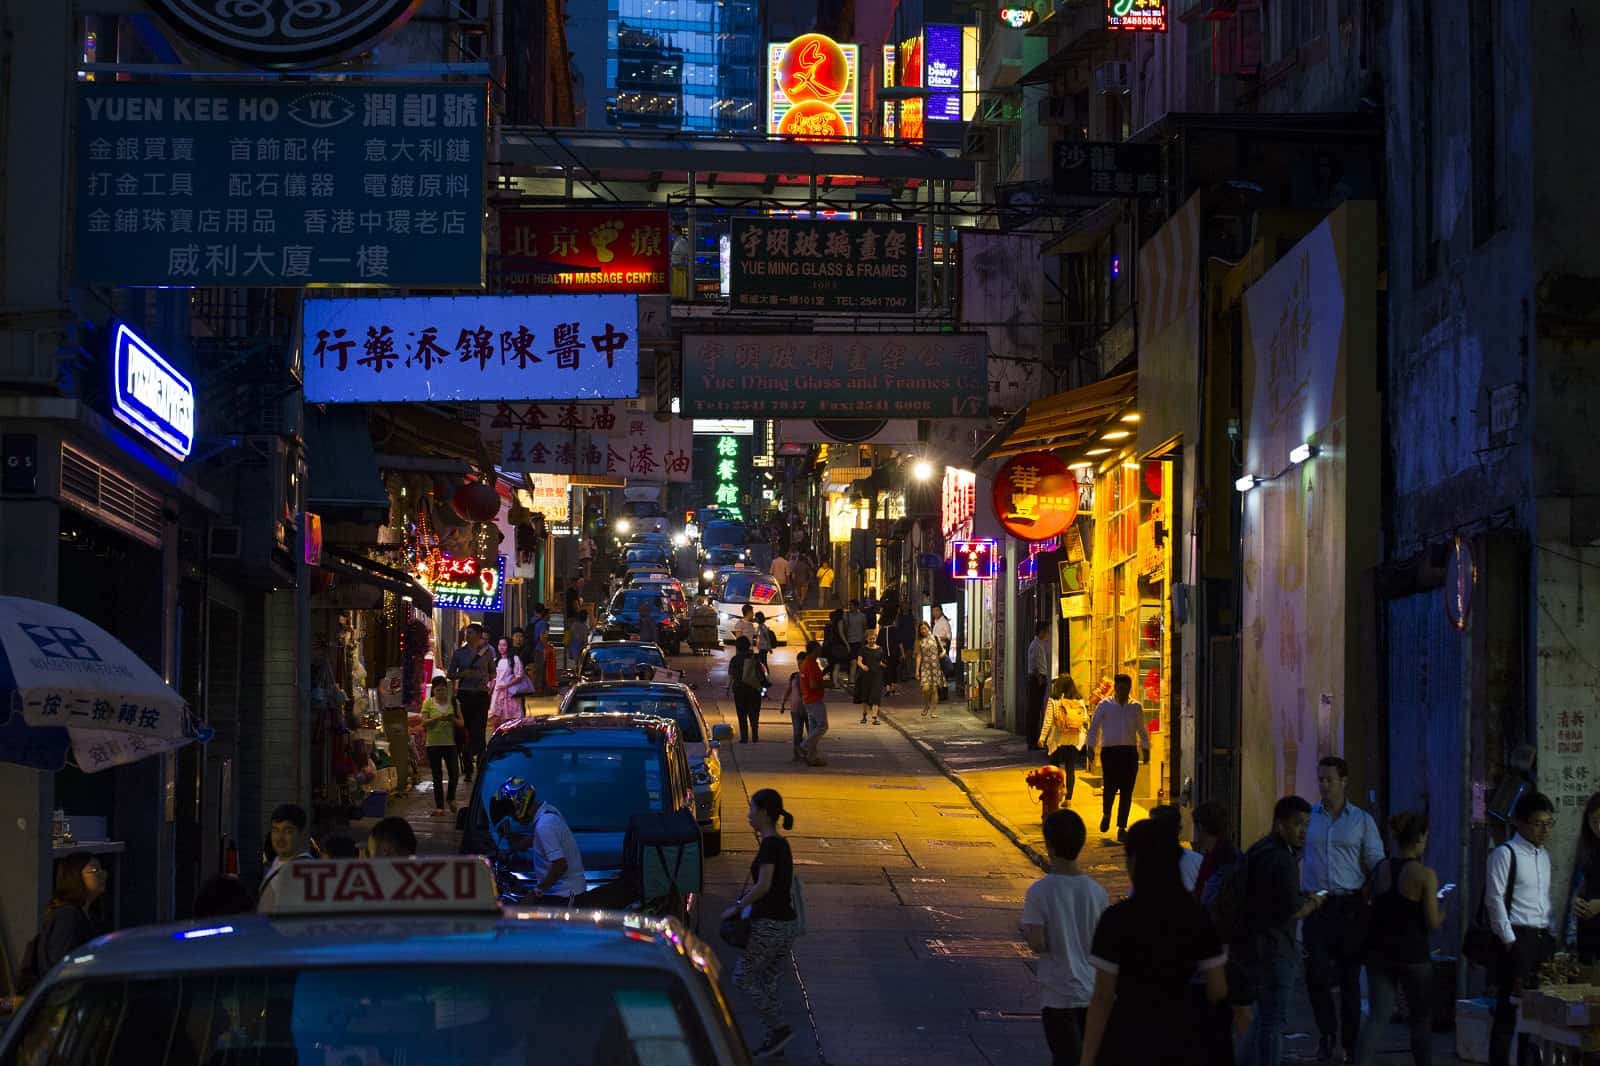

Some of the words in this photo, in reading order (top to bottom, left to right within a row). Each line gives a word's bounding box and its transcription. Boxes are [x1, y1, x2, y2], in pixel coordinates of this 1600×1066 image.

[928, 64, 958, 78] beauty
[86, 98, 163, 121] YUEN
[173, 98, 229, 121] KEE
[239, 98, 279, 121] HO
[308, 99, 334, 120] YK
[87, 137, 195, 162] 金銀買賣
[228, 137, 336, 162] 首飾配件
[363, 137, 471, 163] 意大利鏈
[87, 172, 193, 197] 打金工具
[228, 172, 336, 198] 配石儀器
[363, 172, 470, 198] 電鍍原料
[304, 208, 466, 235] 香港中環老店
[508, 224, 580, 257] 北京
[167, 243, 391, 278] 威利大廈一樓
[741, 262, 766, 275] YUE
[768, 262, 799, 276] MING
[801, 262, 842, 277] GLASS
[846, 264, 856, 276] &
[857, 264, 907, 278] FRAMES
[534, 272, 573, 284] HEALTH
[575, 272, 623, 285] MASSAGE
[626, 272, 664, 284] CENTRE
[313, 322, 629, 372] 中醫陳錦添藥行
[292, 863, 477, 901] TAXI
